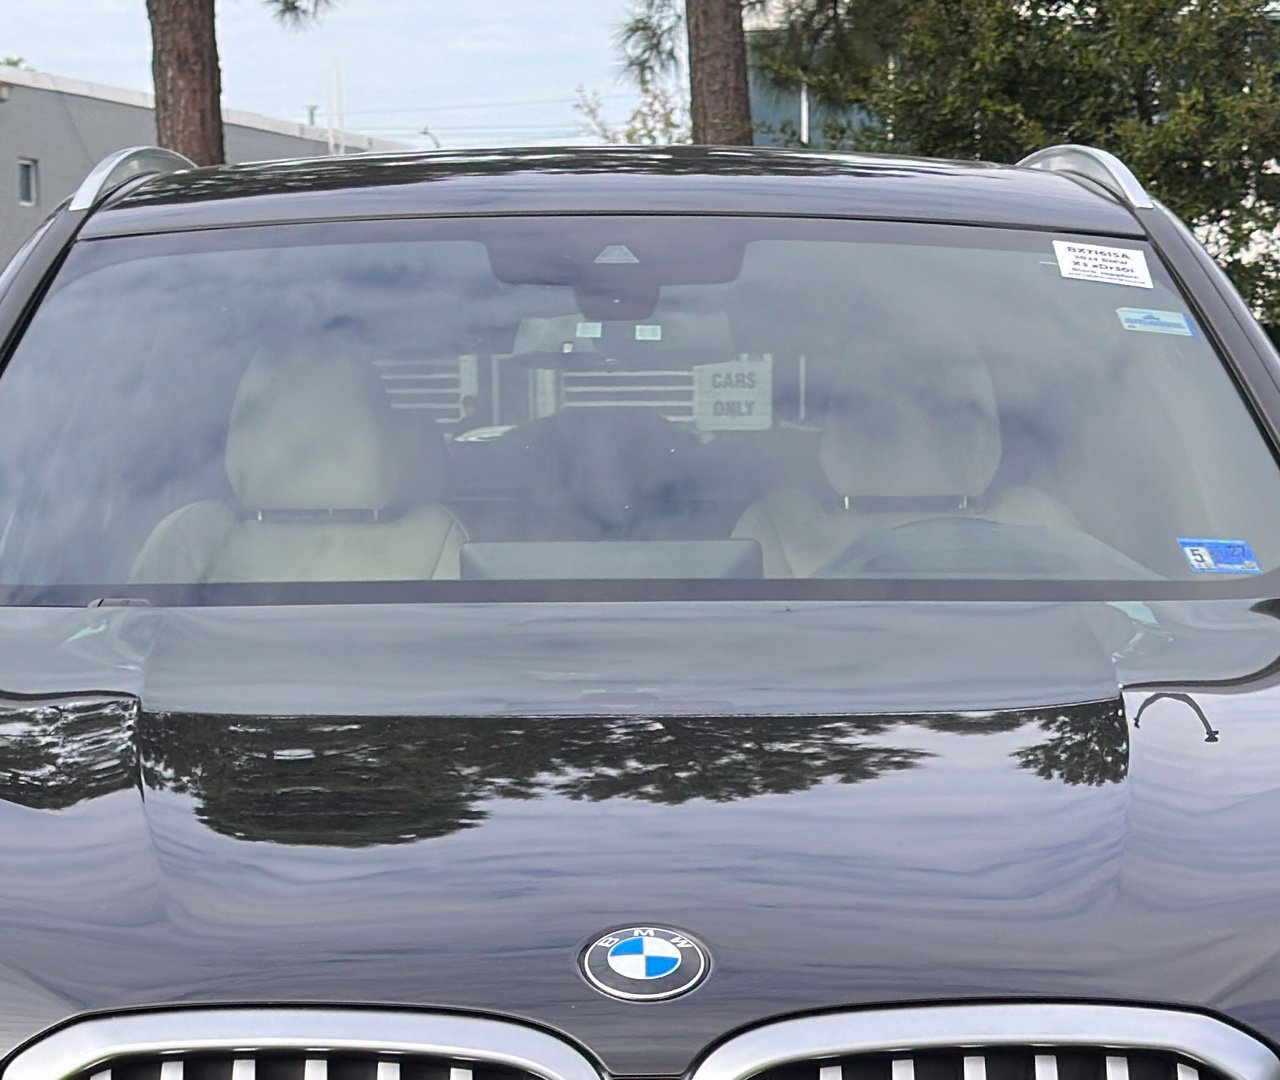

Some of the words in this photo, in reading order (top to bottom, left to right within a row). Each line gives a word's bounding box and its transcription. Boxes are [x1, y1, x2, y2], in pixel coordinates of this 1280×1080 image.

[711, 372, 757, 390] CARS
[713, 400, 756, 417] ONLY
[1189, 548, 1206, 563] 5
[596, 928, 694, 949] BMW
